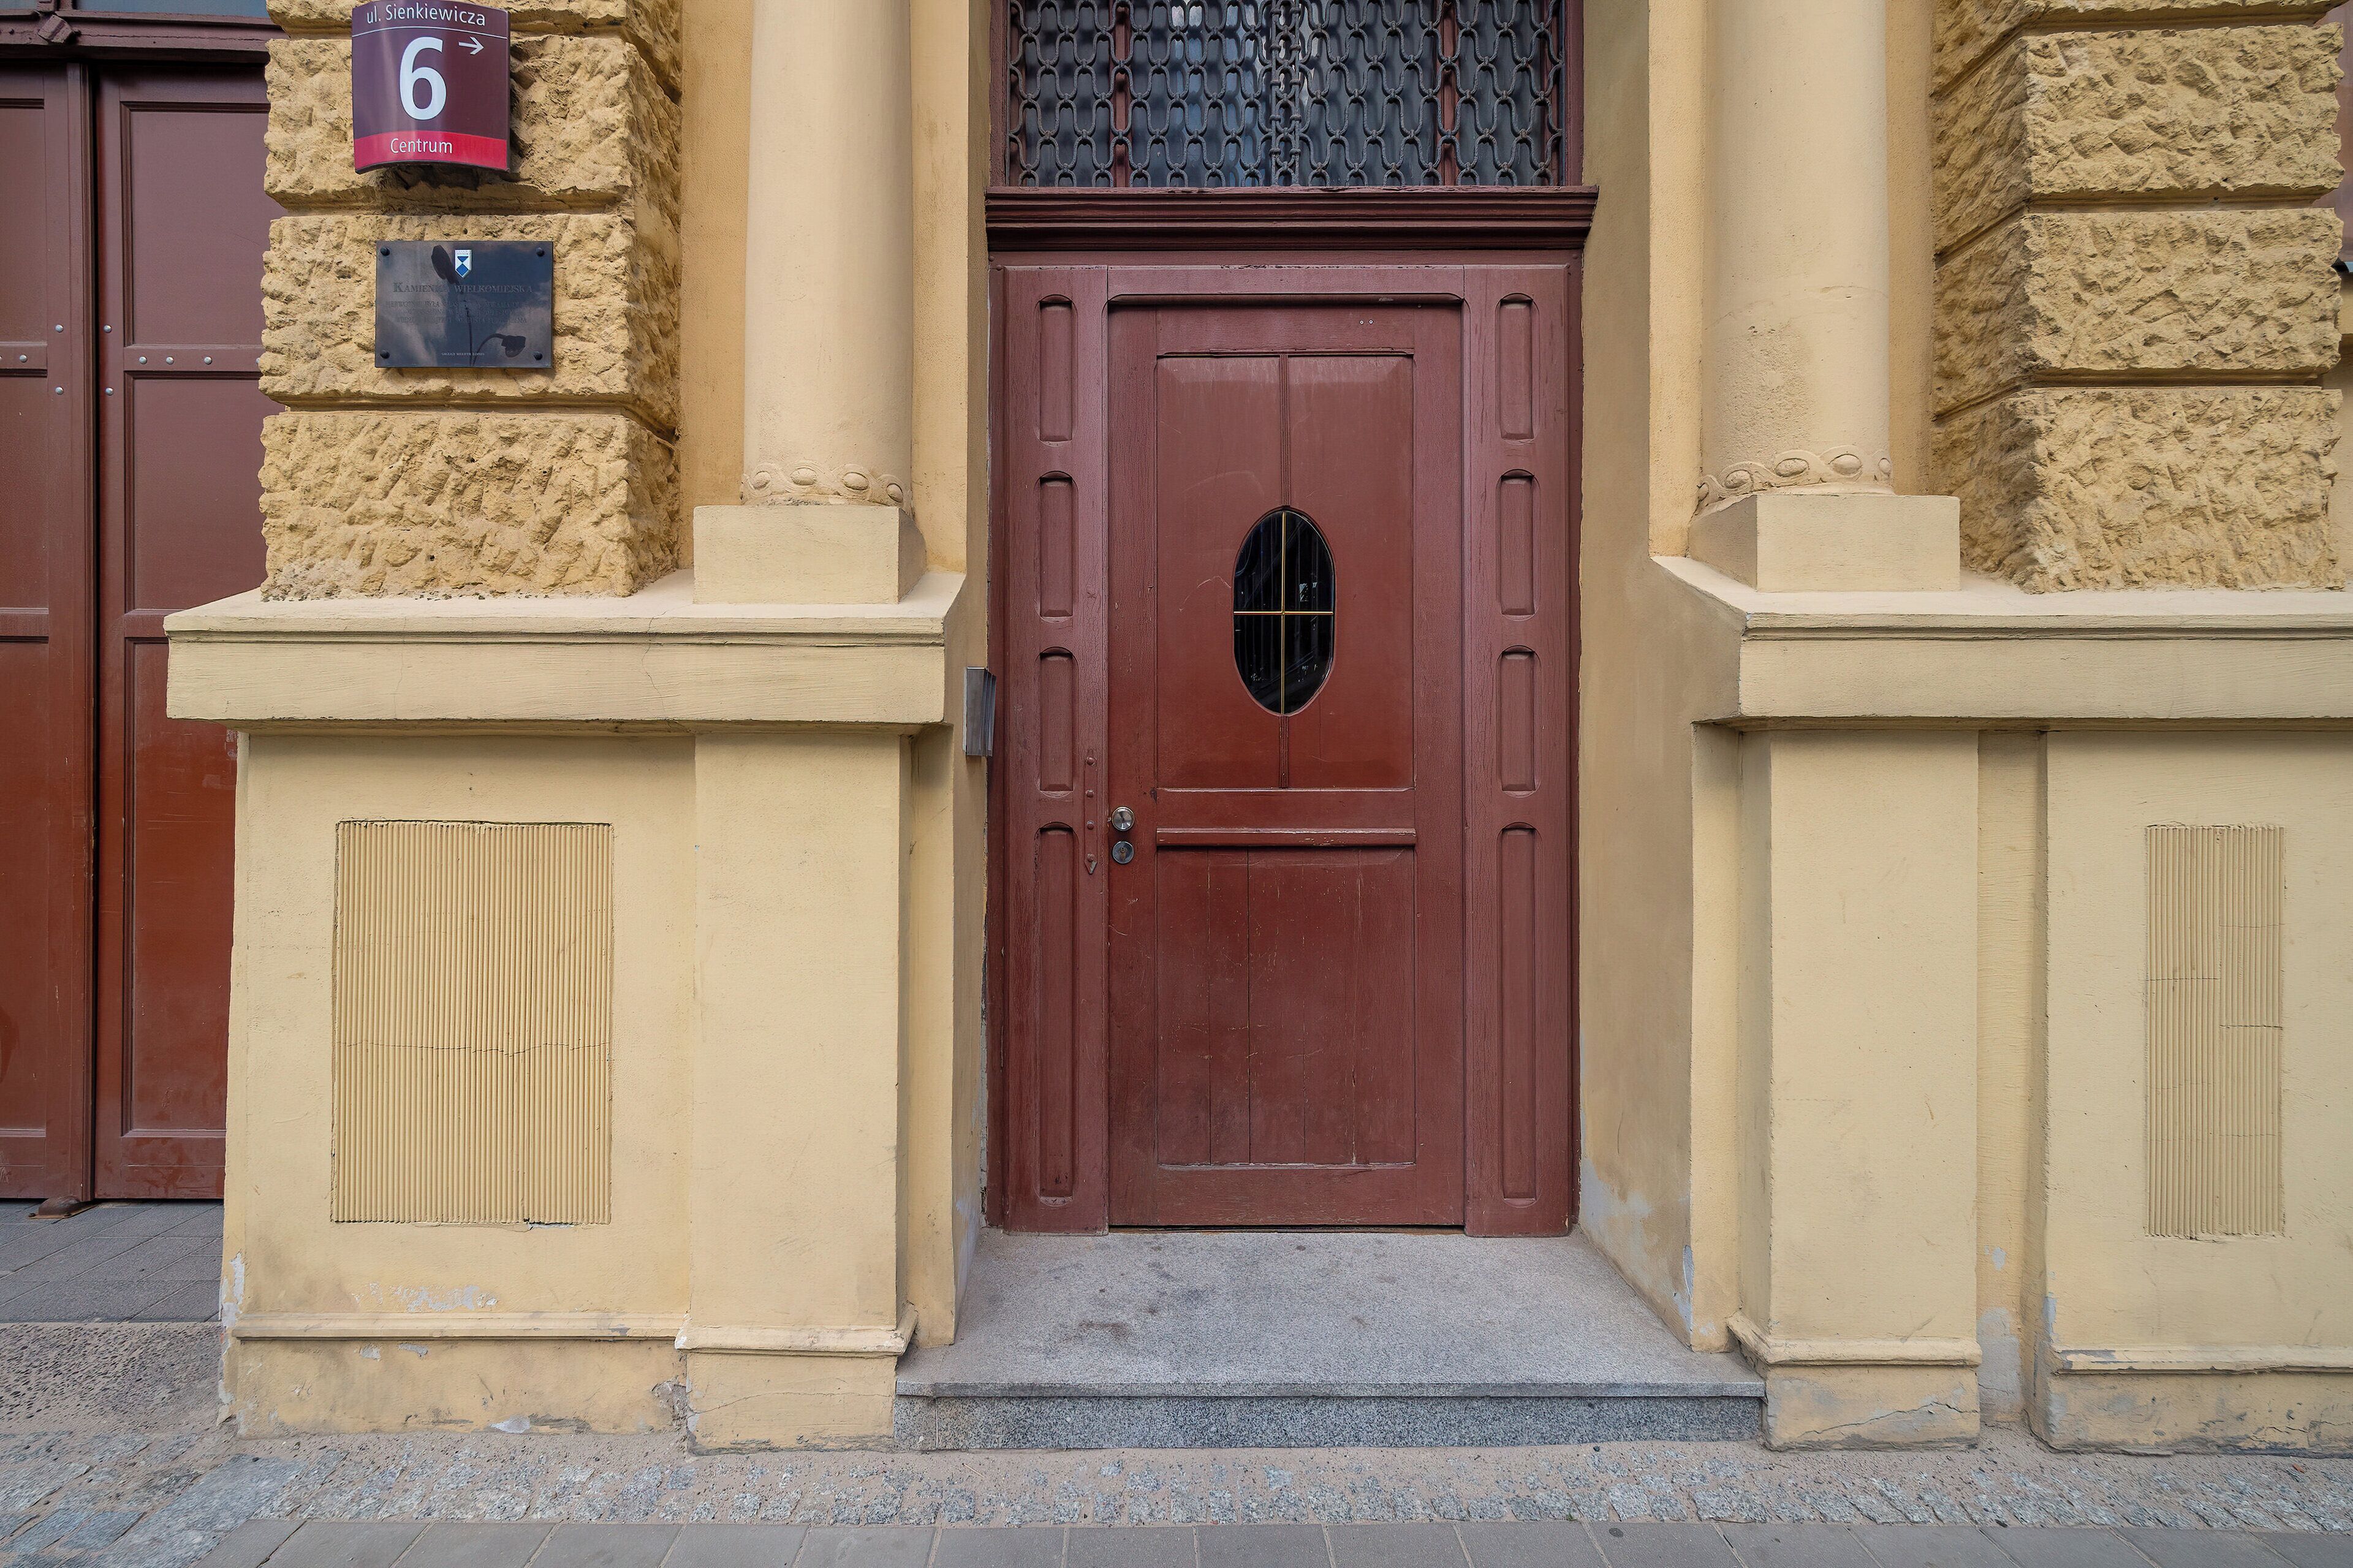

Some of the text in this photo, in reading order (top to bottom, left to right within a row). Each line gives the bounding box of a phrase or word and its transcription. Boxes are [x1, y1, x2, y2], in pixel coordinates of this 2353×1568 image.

[367, 2, 485, 26] ul. Sienkiewicza
[400, 36, 447, 120] 6
[390, 138, 453, 154] Centrum
